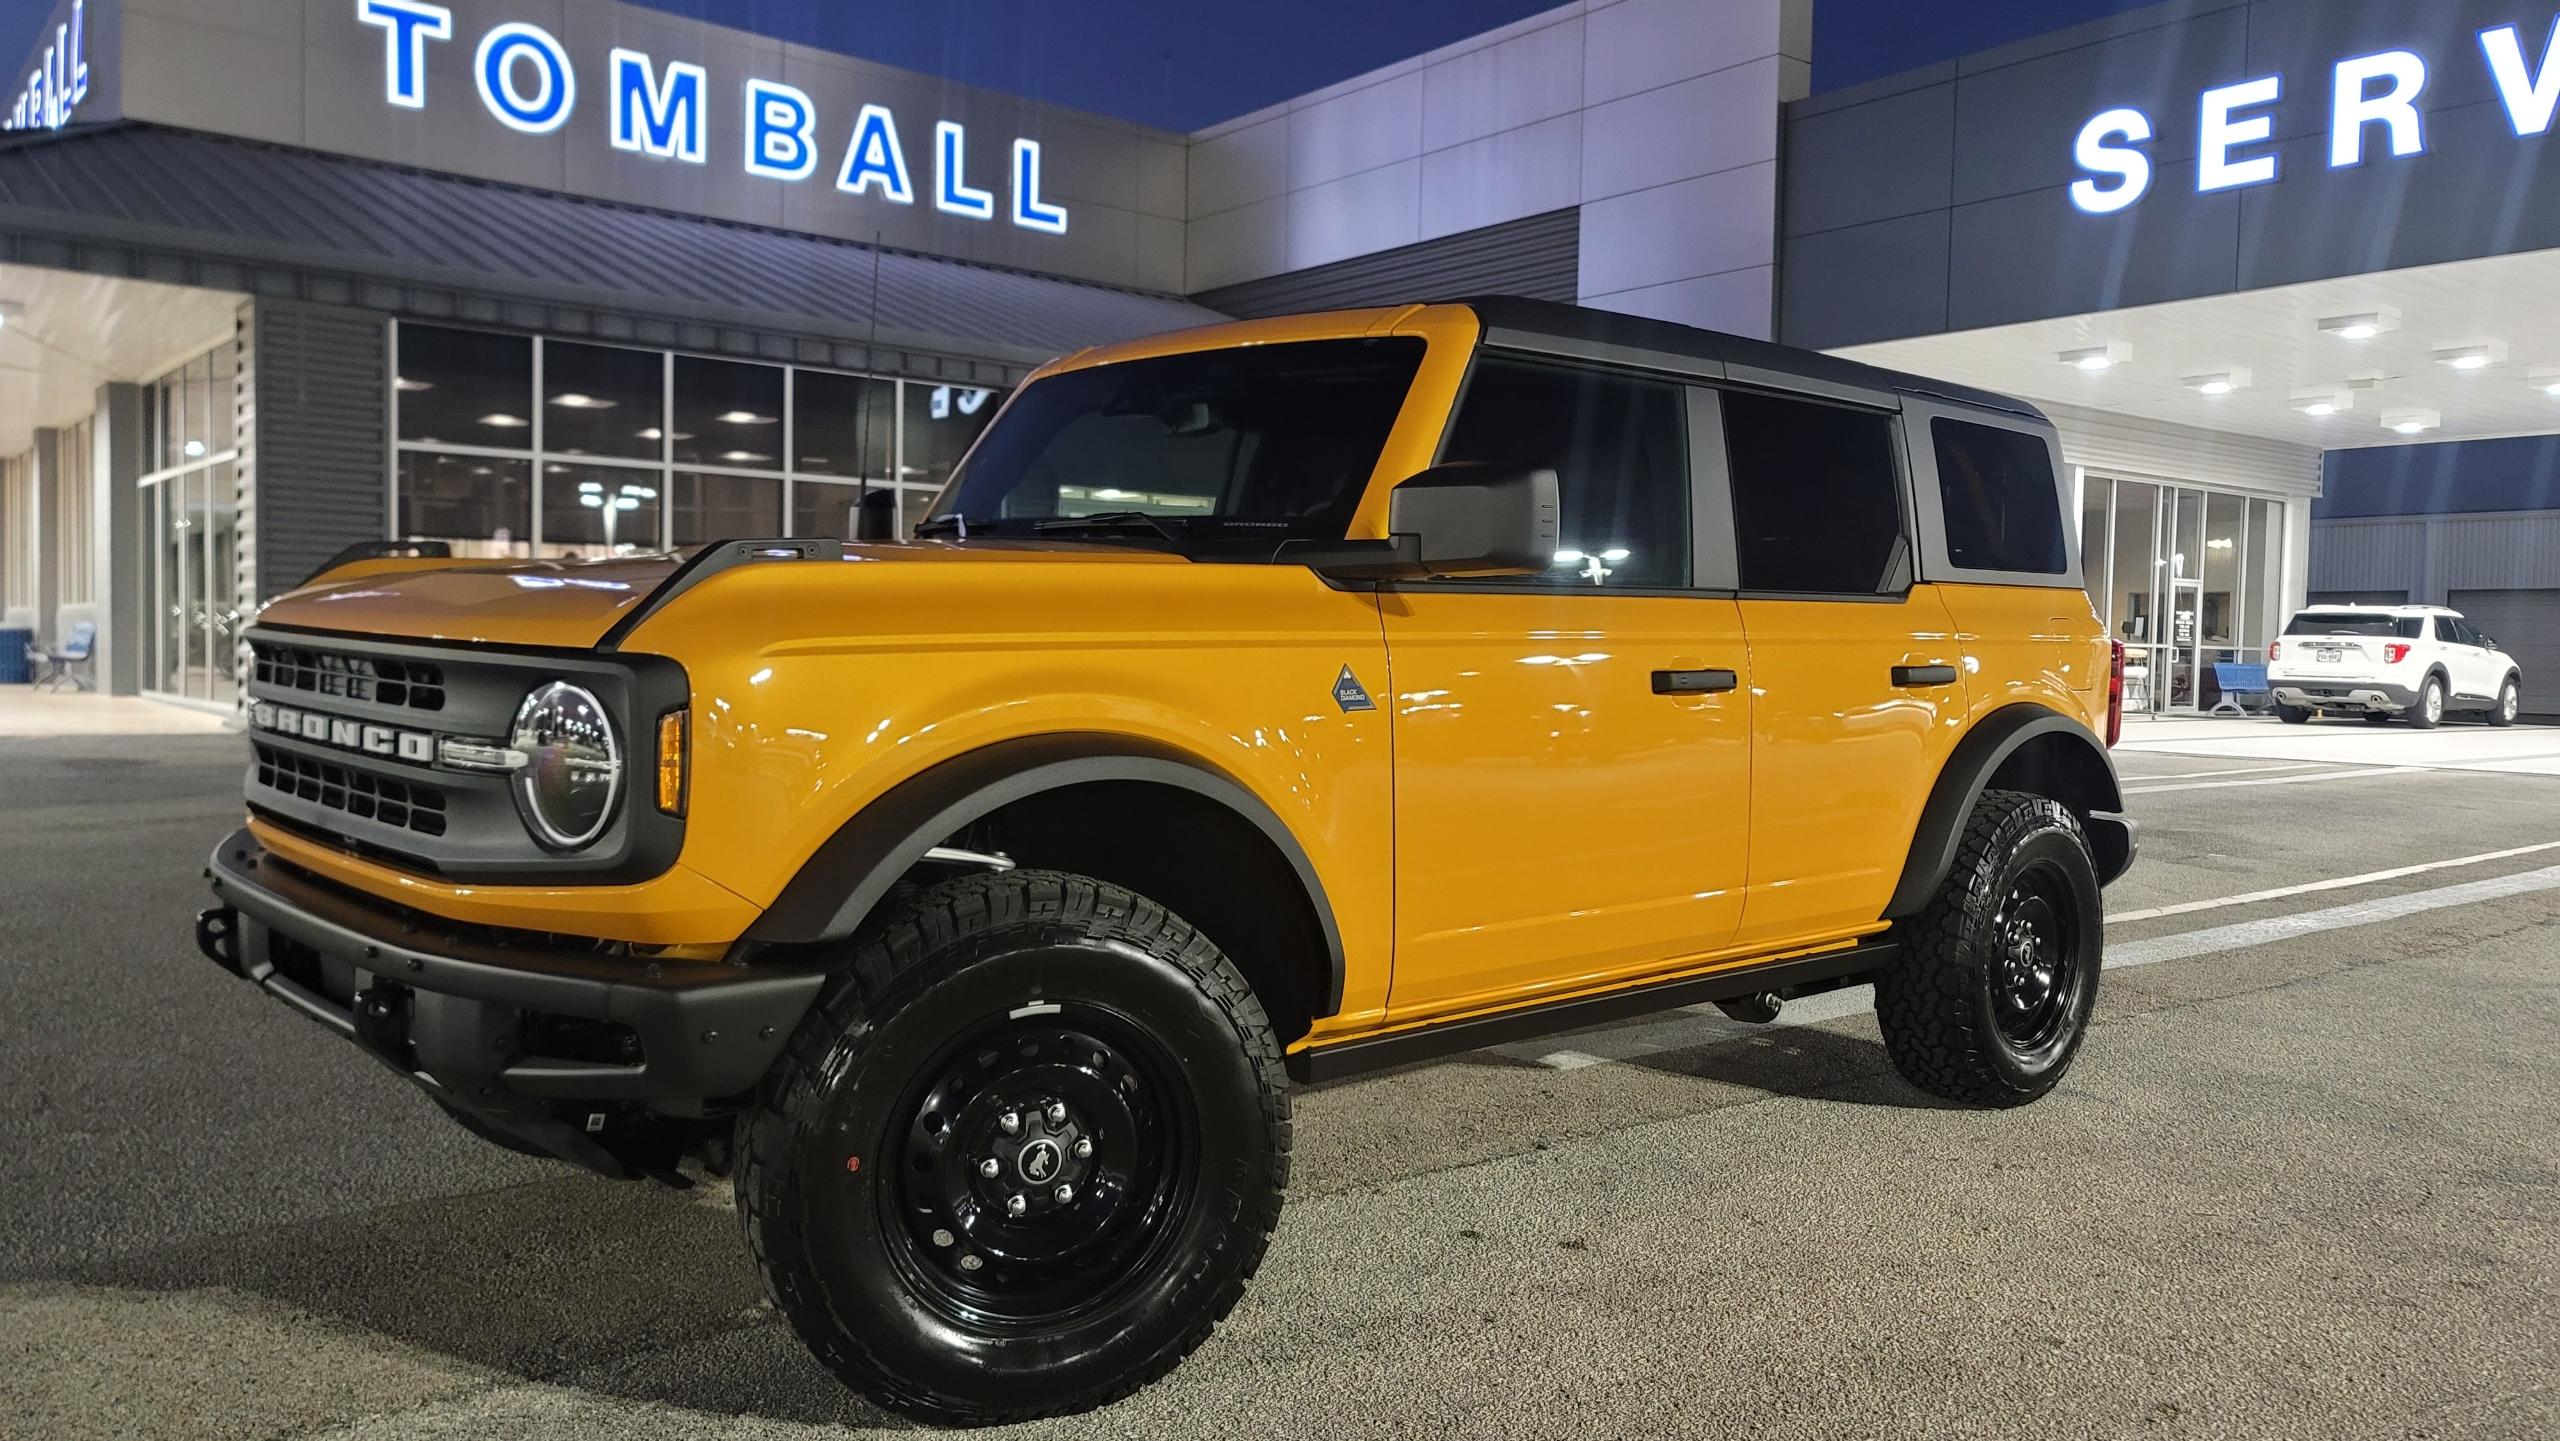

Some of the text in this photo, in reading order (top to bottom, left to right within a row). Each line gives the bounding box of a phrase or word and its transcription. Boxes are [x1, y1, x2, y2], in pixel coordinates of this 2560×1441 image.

[358, 0, 1067, 234] TOMBALL
[2069, 14, 2560, 215] SERV
[253, 702, 434, 762] BRONCO
[1340, 694, 1365, 702] DIAMOND
